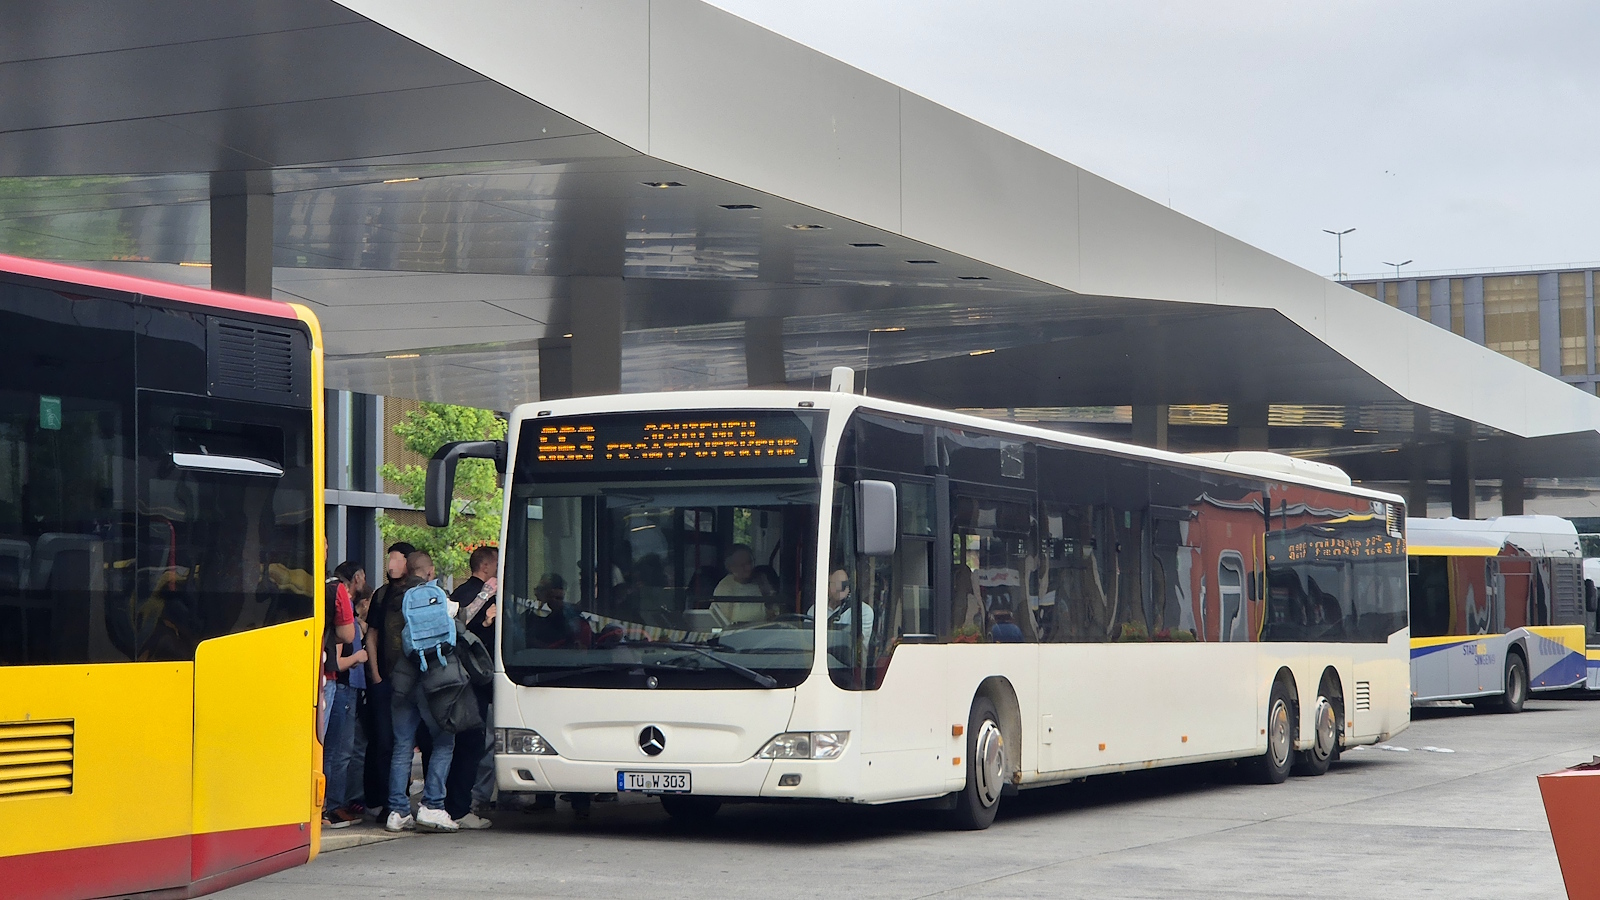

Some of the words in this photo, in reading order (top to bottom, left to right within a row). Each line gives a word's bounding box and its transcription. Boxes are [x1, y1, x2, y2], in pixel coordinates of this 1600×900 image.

[629, 775, 644, 787] TÜ
[652, 775, 660, 788] W
[663, 775, 685, 788] 303
